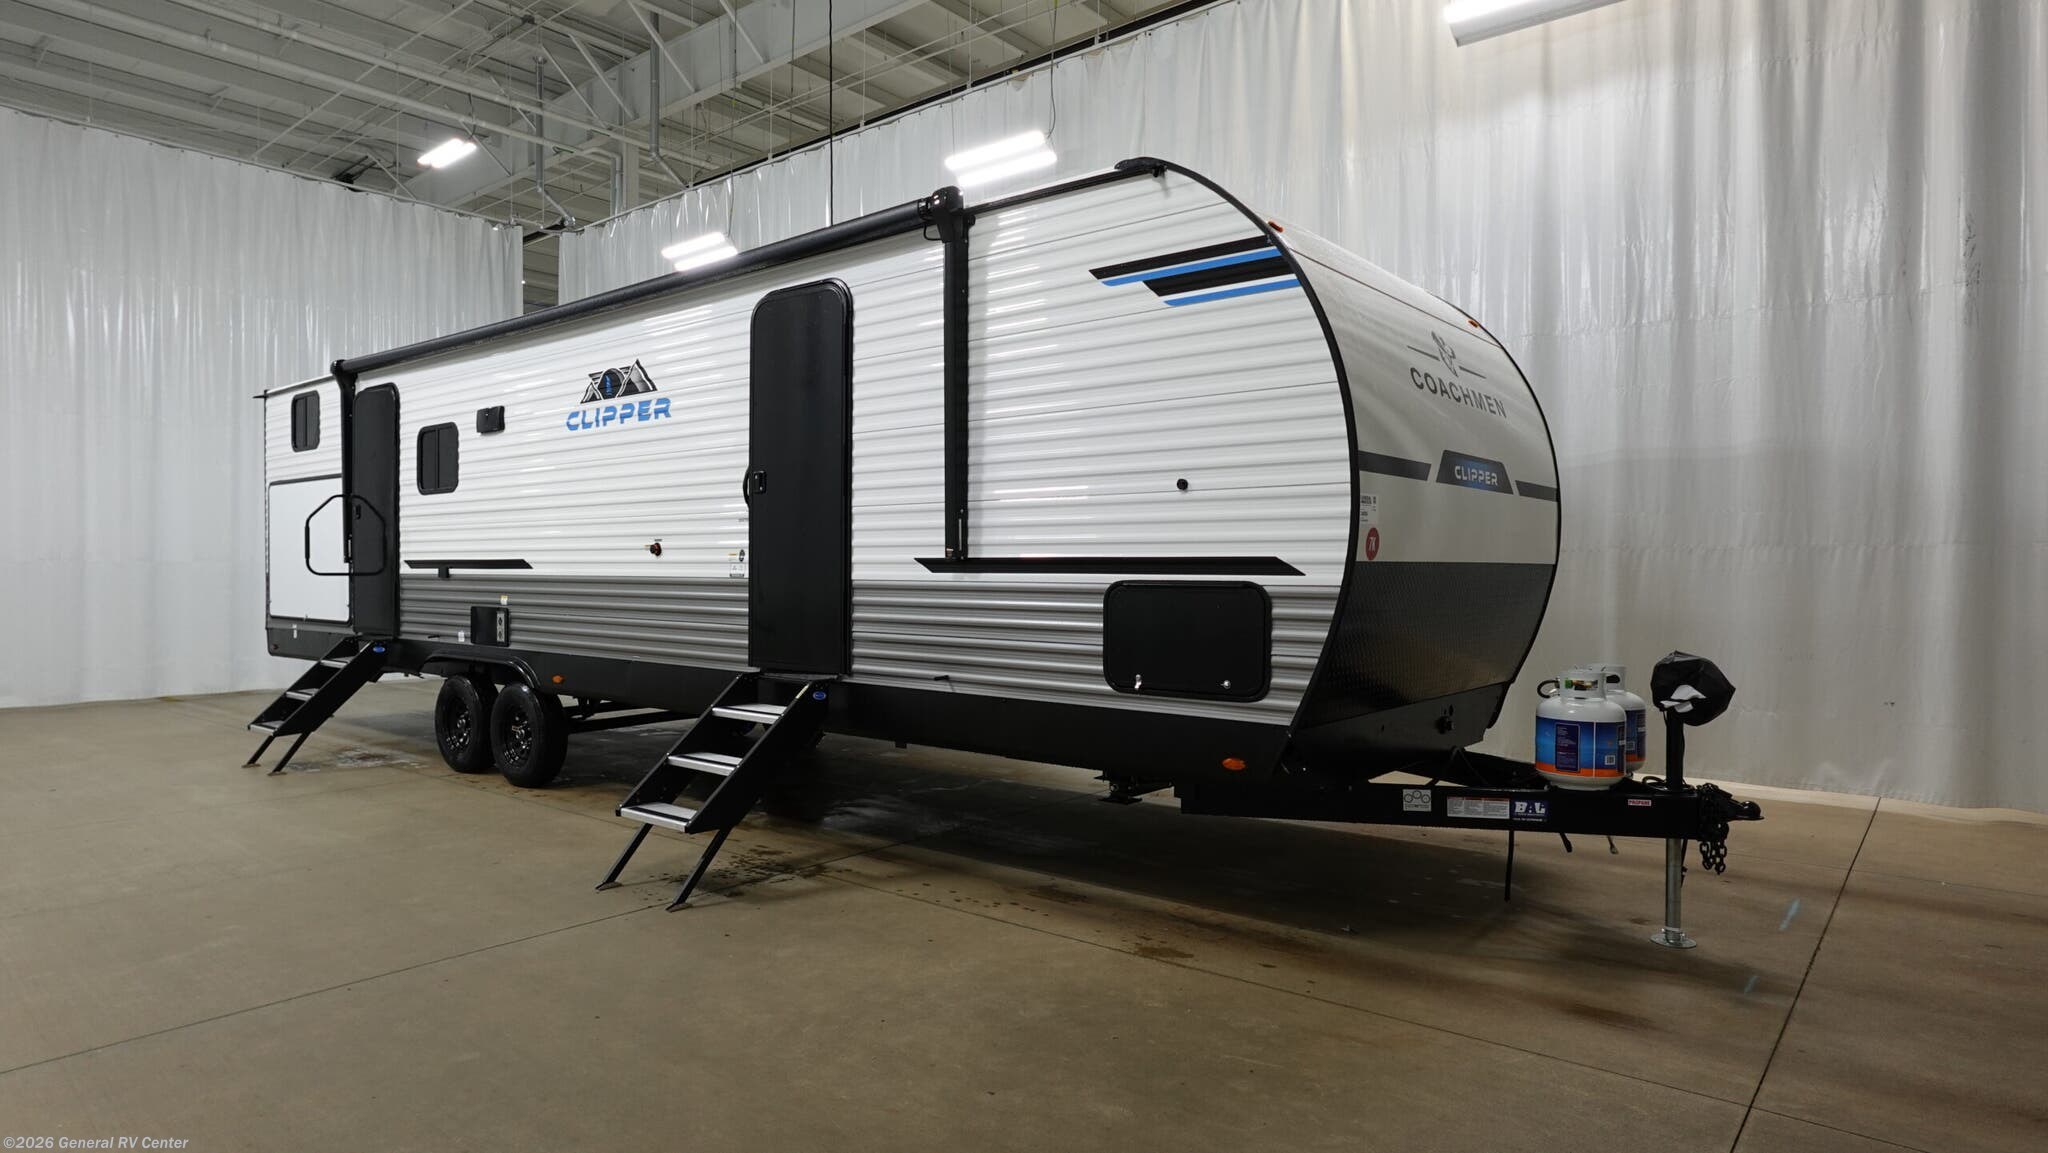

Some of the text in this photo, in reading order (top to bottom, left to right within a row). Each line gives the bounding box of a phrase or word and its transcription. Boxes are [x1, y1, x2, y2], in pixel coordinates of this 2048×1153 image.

[1410, 367, 1507, 419] COACHMEN
[566, 397, 671, 431] CLIPPER
[1454, 465, 1498, 486] CLIPPER
